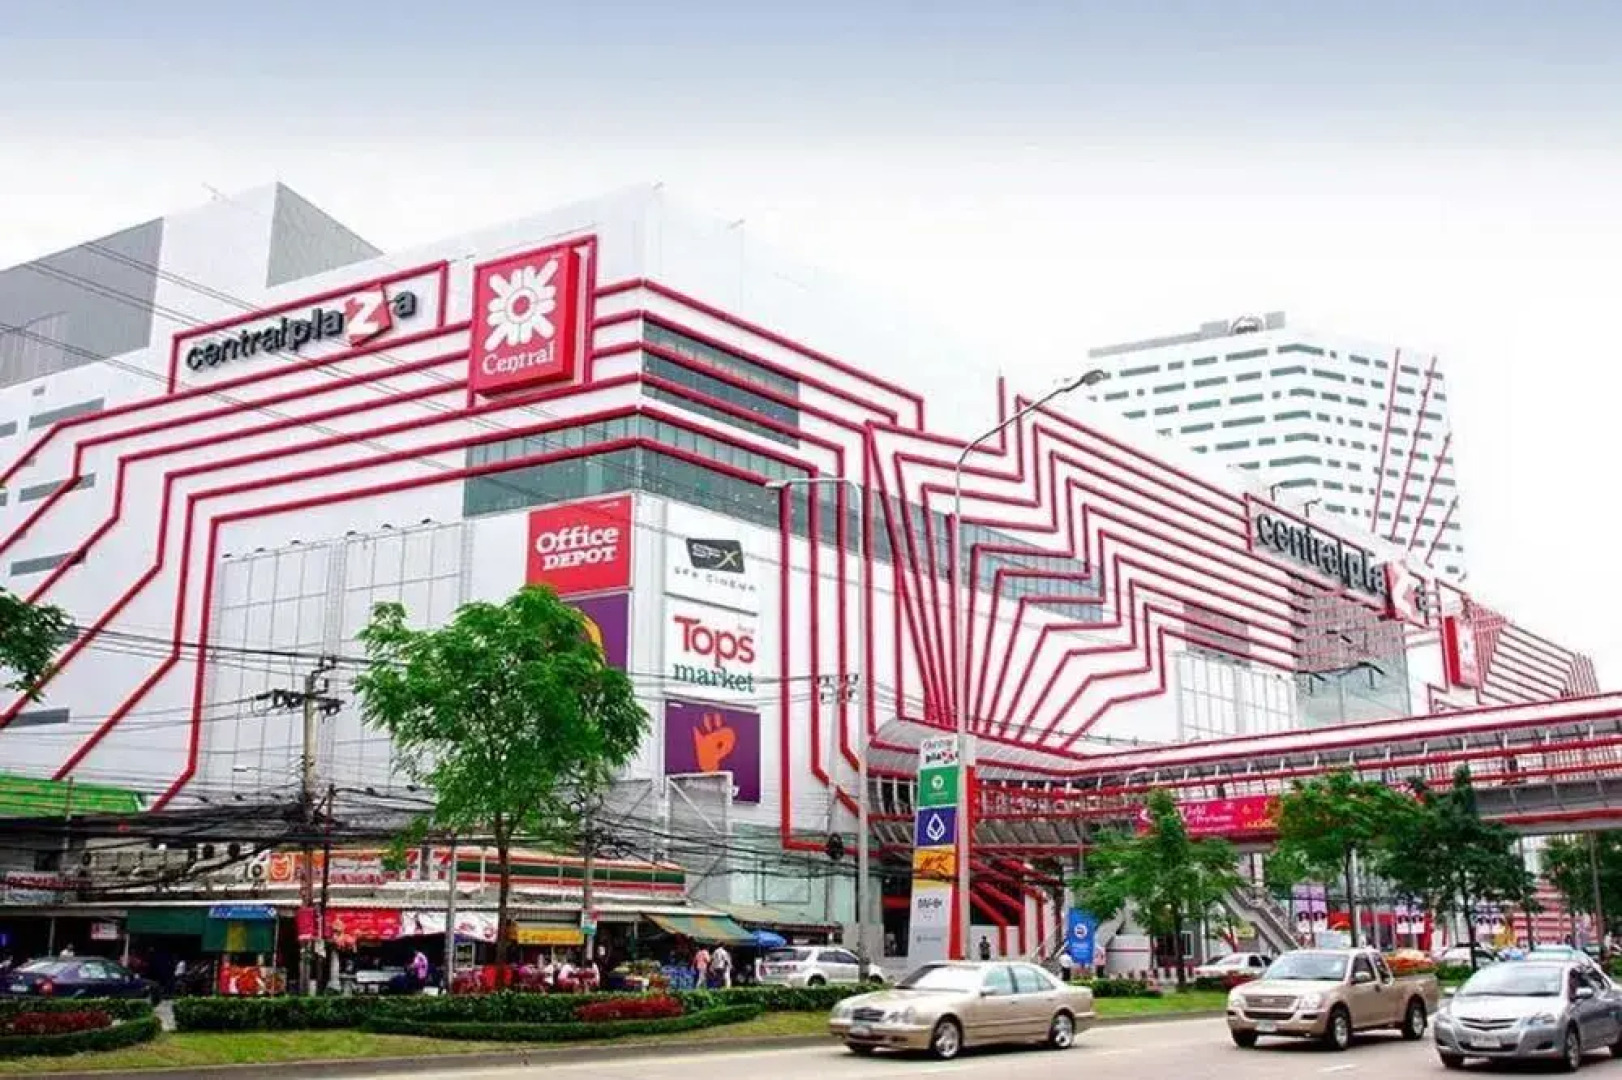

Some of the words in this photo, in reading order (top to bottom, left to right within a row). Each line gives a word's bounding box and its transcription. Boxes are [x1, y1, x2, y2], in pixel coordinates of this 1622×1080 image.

[187, 287, 417, 370] centralplaza
[482, 339, 556, 375] Central
[536, 525, 619, 554] Office
[542, 545, 617, 571] DEPOT
[673, 615, 755, 668] Tops
[673, 663, 755, 694] market
